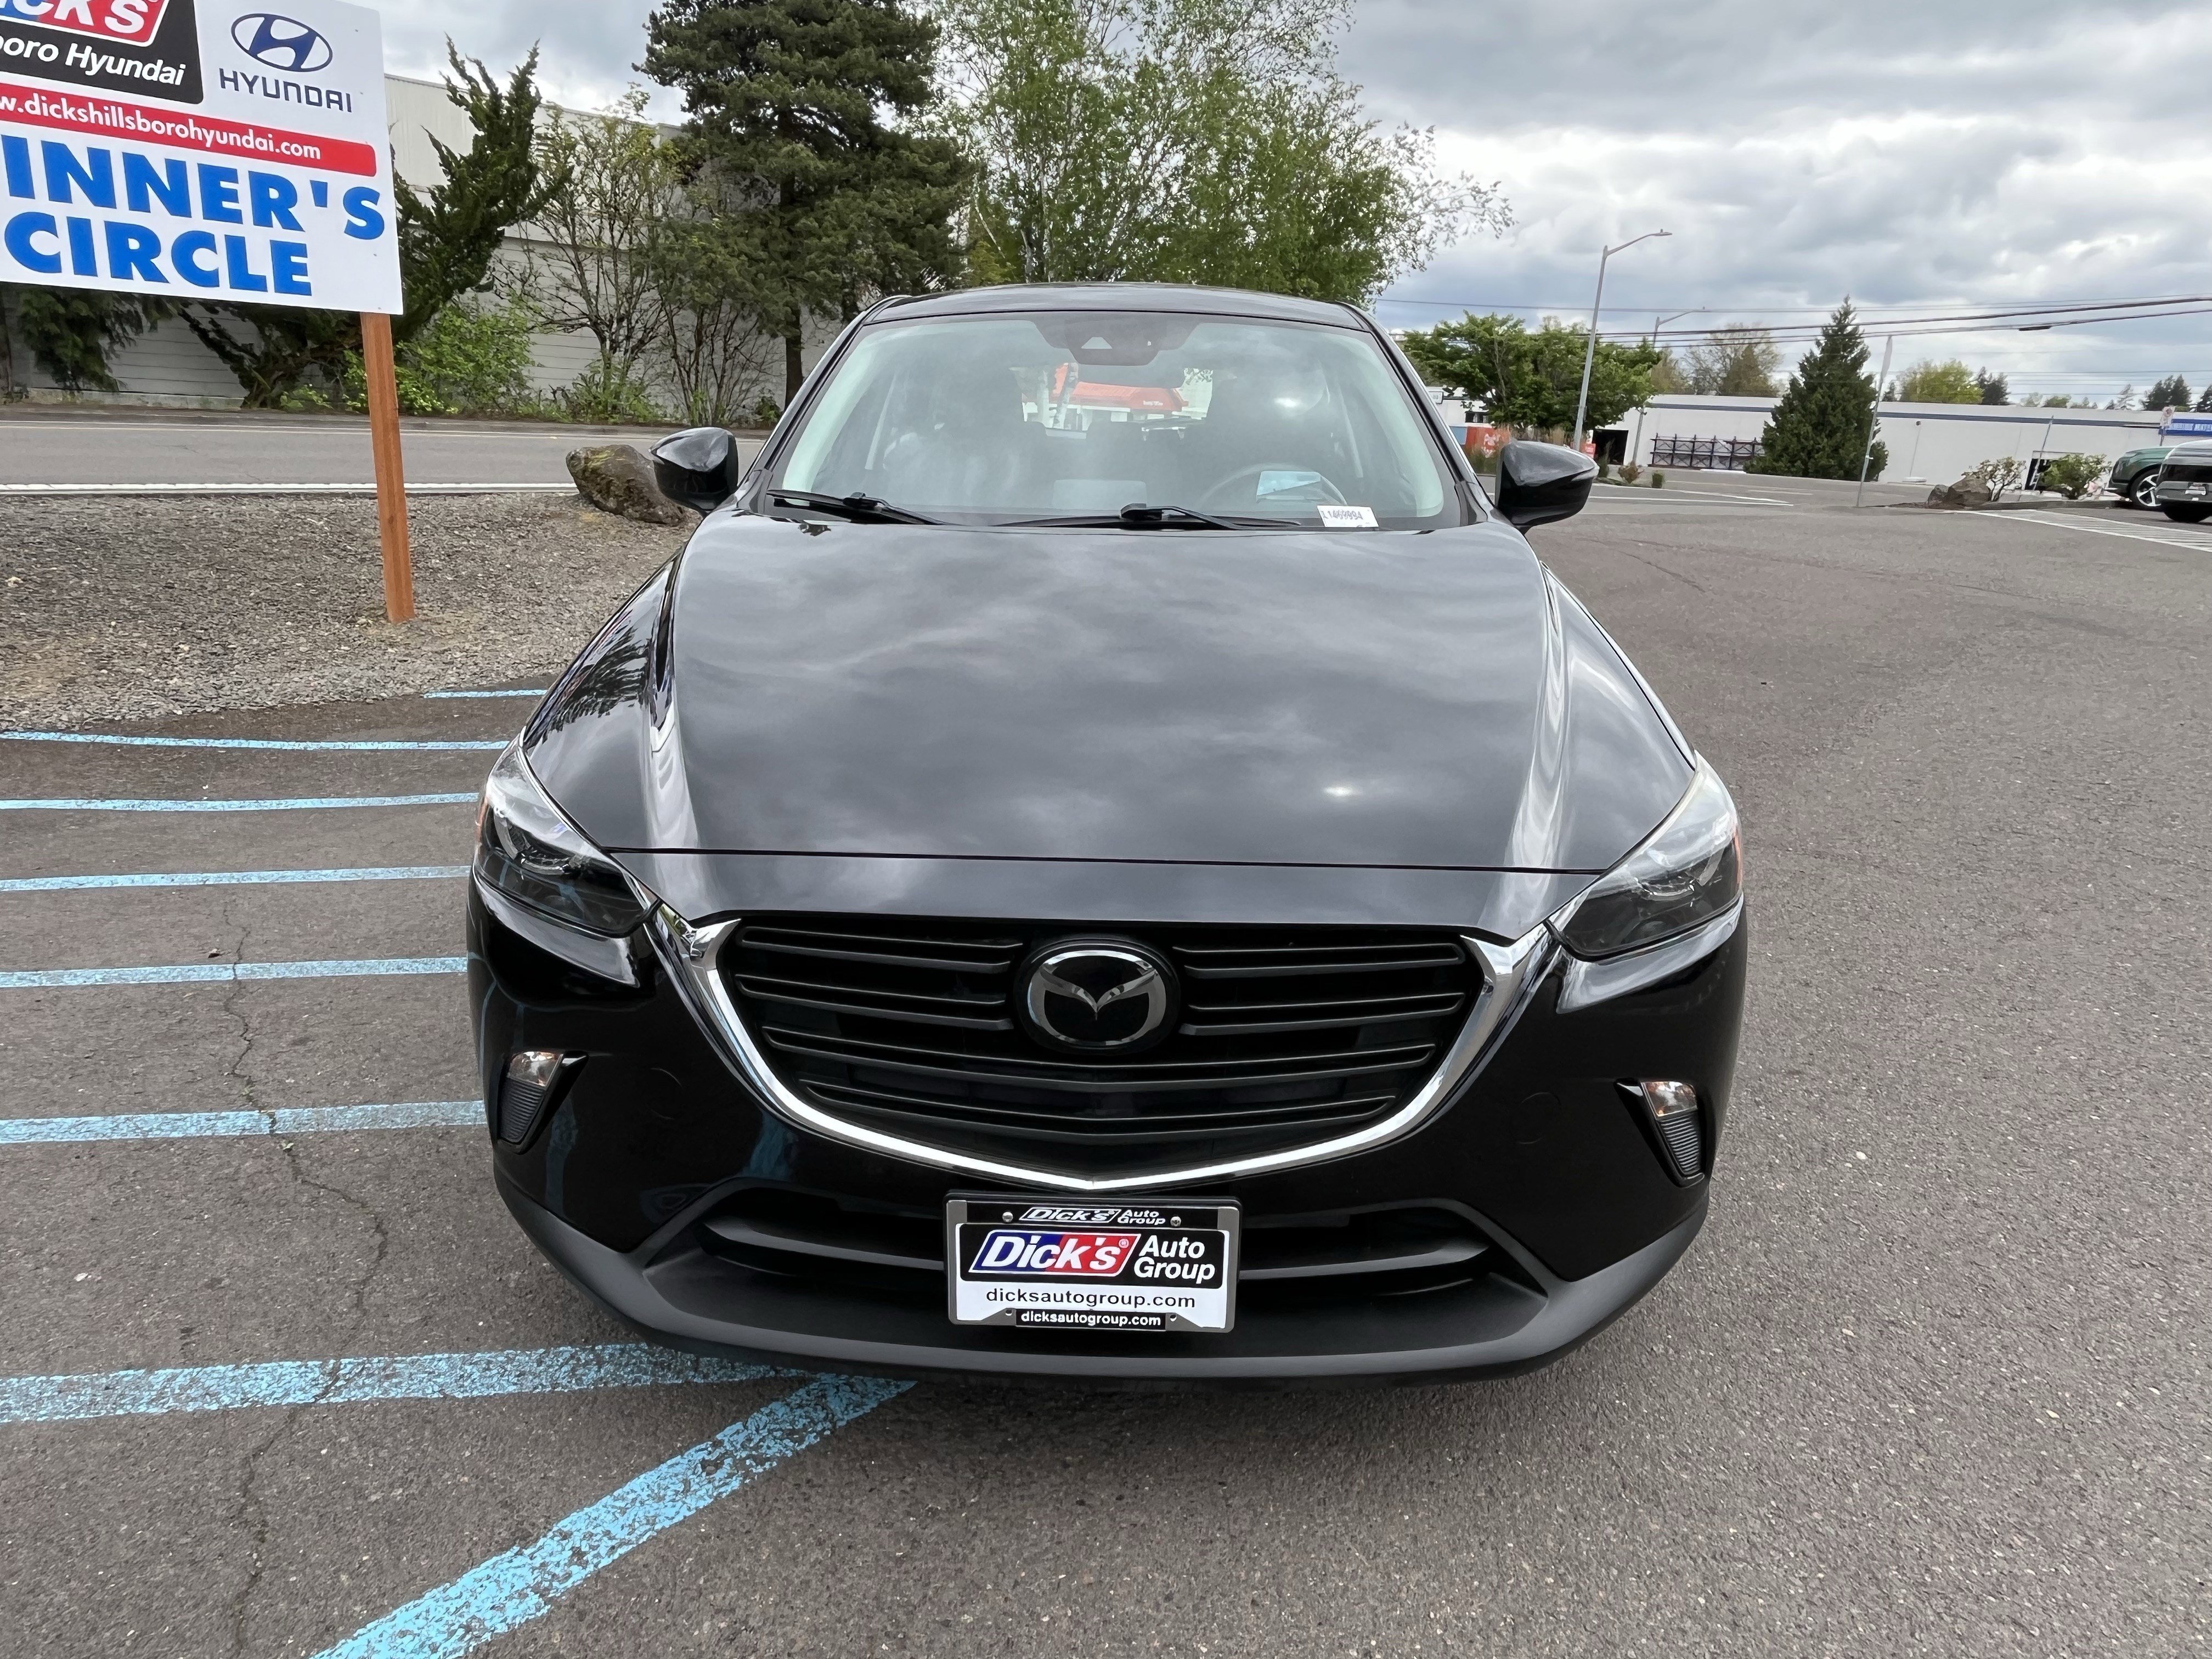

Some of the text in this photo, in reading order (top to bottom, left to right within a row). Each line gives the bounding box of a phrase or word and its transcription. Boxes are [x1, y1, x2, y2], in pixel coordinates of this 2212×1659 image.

[65, 43, 186, 86] Hyundai
[219, 68, 352, 113] HYUNDAI
[4, 212, 312, 296] CIRCLE
[1117, 1216, 1166, 1226] Group
[1122, 1209, 1159, 1218] Auto
[980, 1235, 1121, 1271] Dick's
[1138, 1235, 1205, 1259] Auto
[1133, 1257, 1216, 1284] Group
[986, 1288, 1196, 1308] dicksautogroup.com
[1020, 1311, 1161, 1327] dicksautogroup.com
